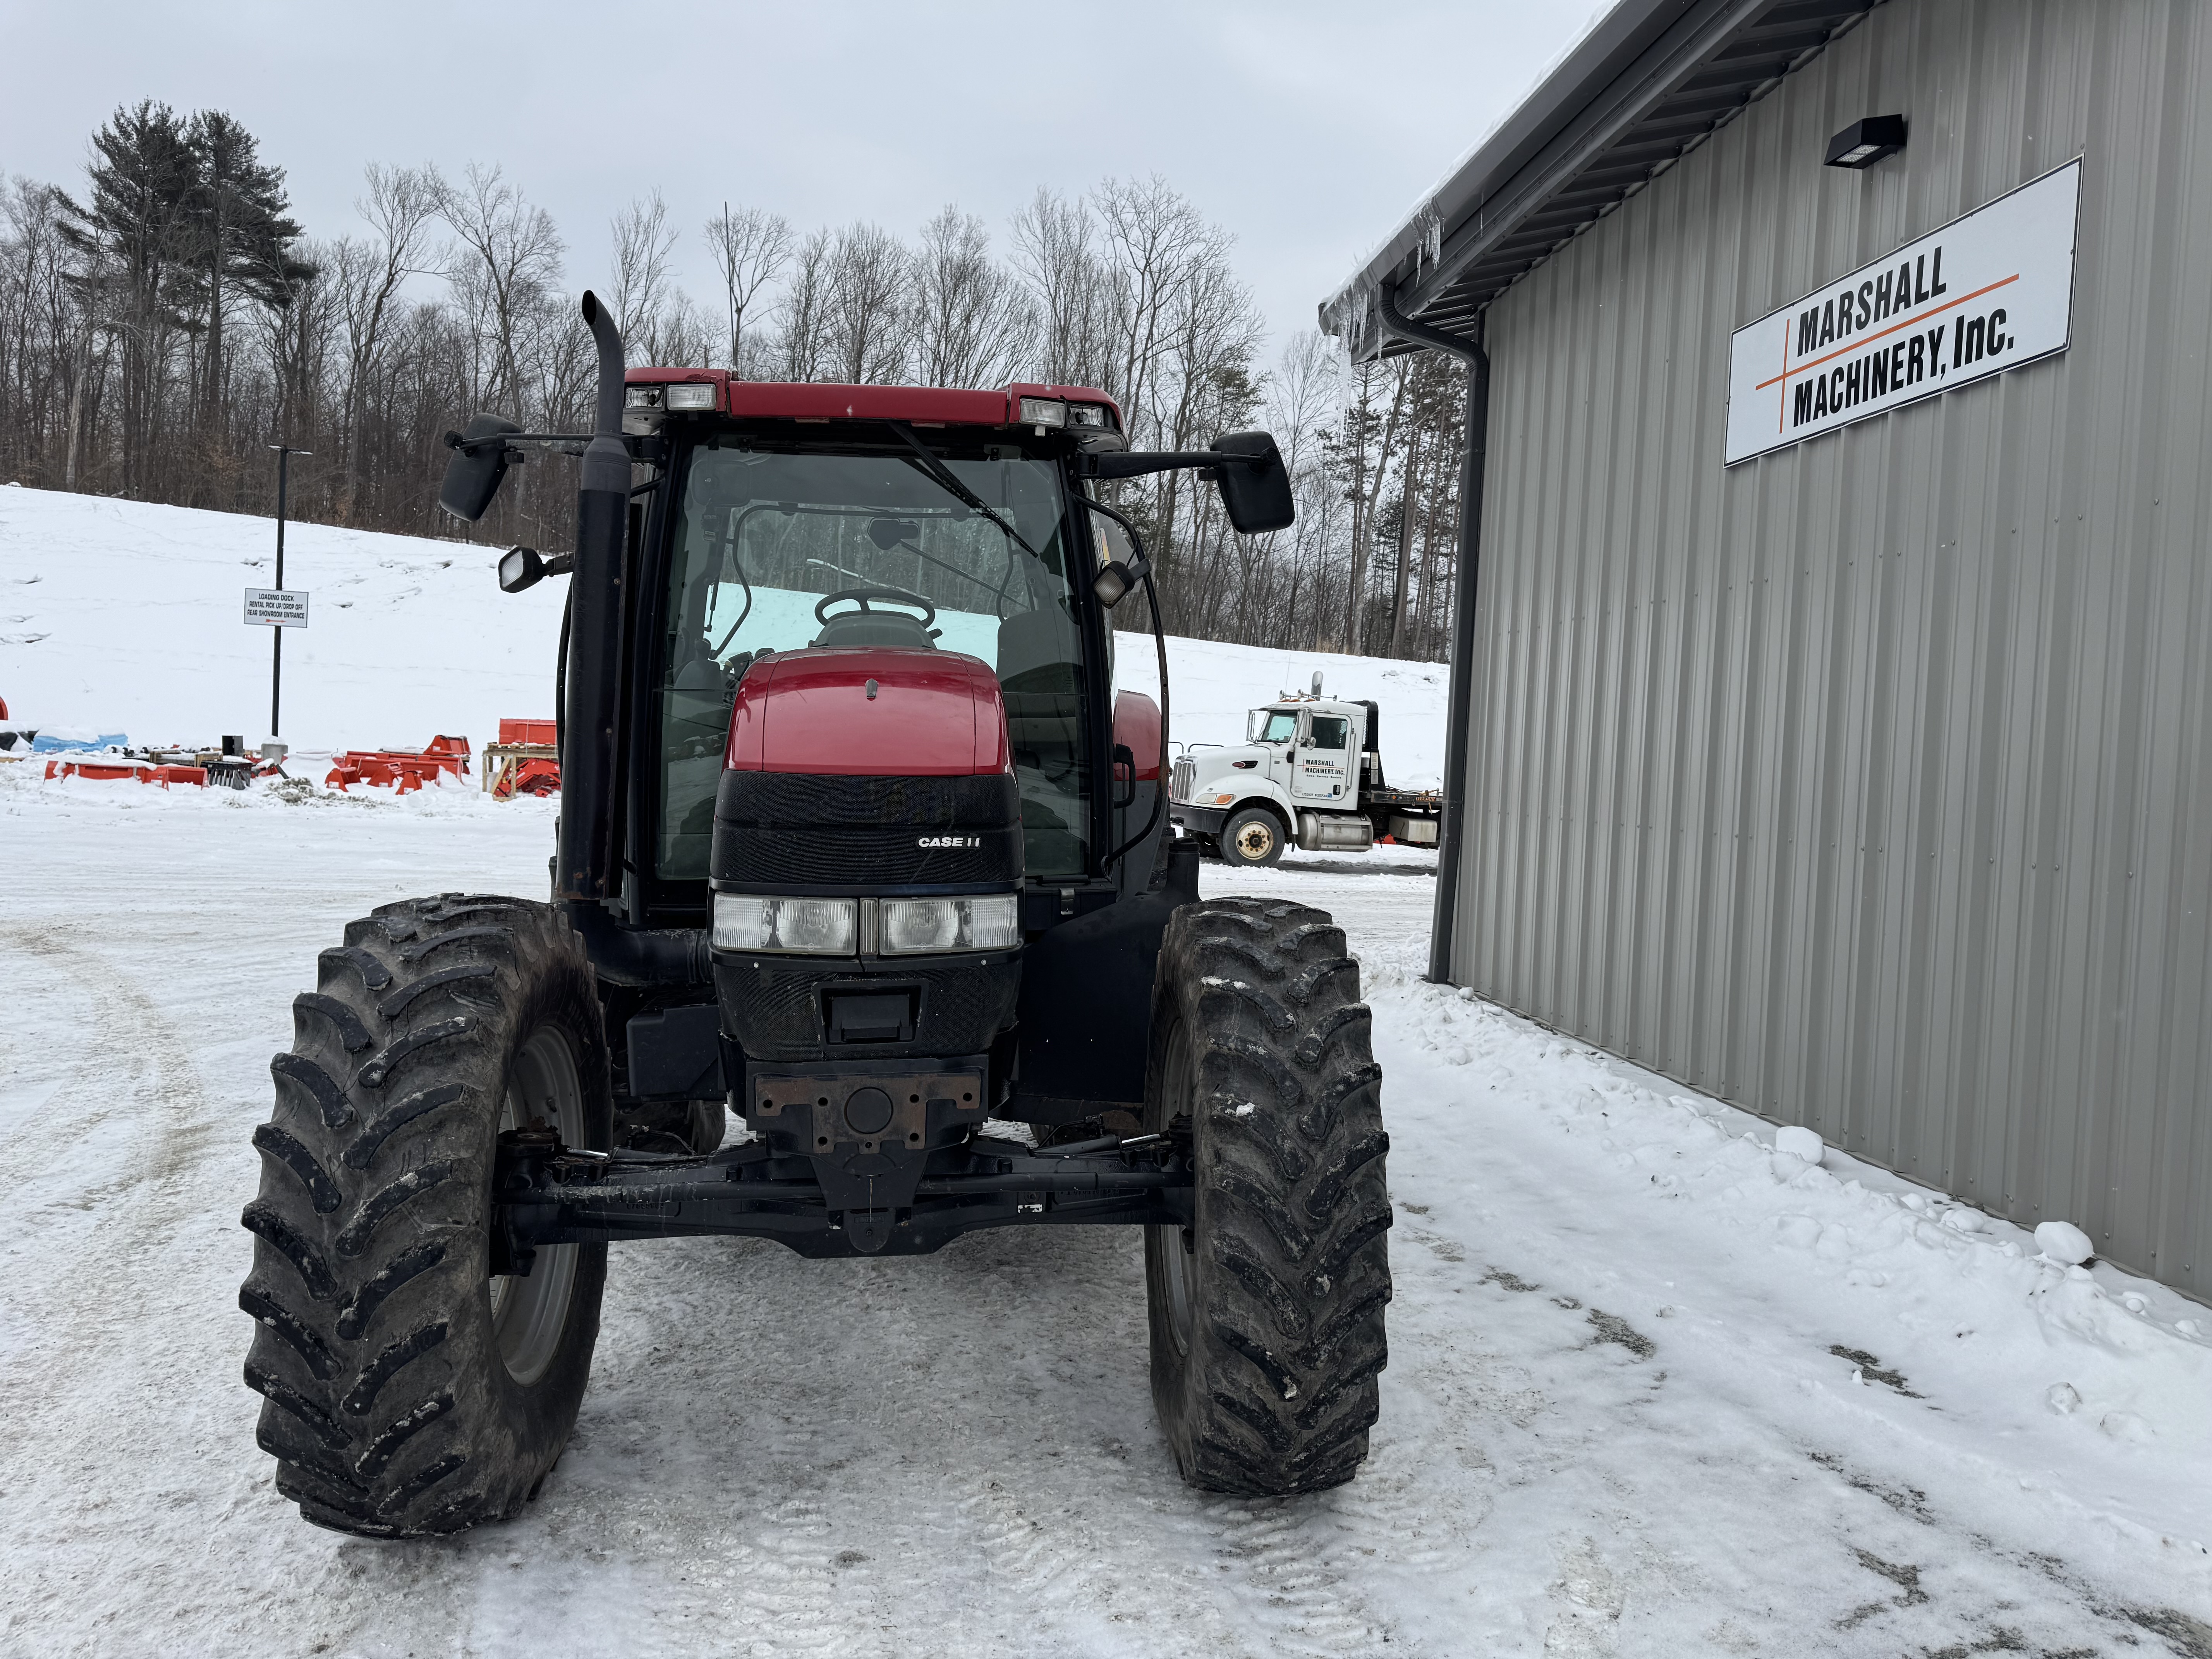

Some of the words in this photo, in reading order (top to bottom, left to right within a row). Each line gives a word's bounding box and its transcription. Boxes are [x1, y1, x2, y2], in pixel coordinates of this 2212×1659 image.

[1797, 246, 1947, 357] MARSHALL
[1793, 324, 1946, 428] MACHINERY,
[1953, 308, 2014, 369] Inc.
[918, 837, 963, 847] CASE
